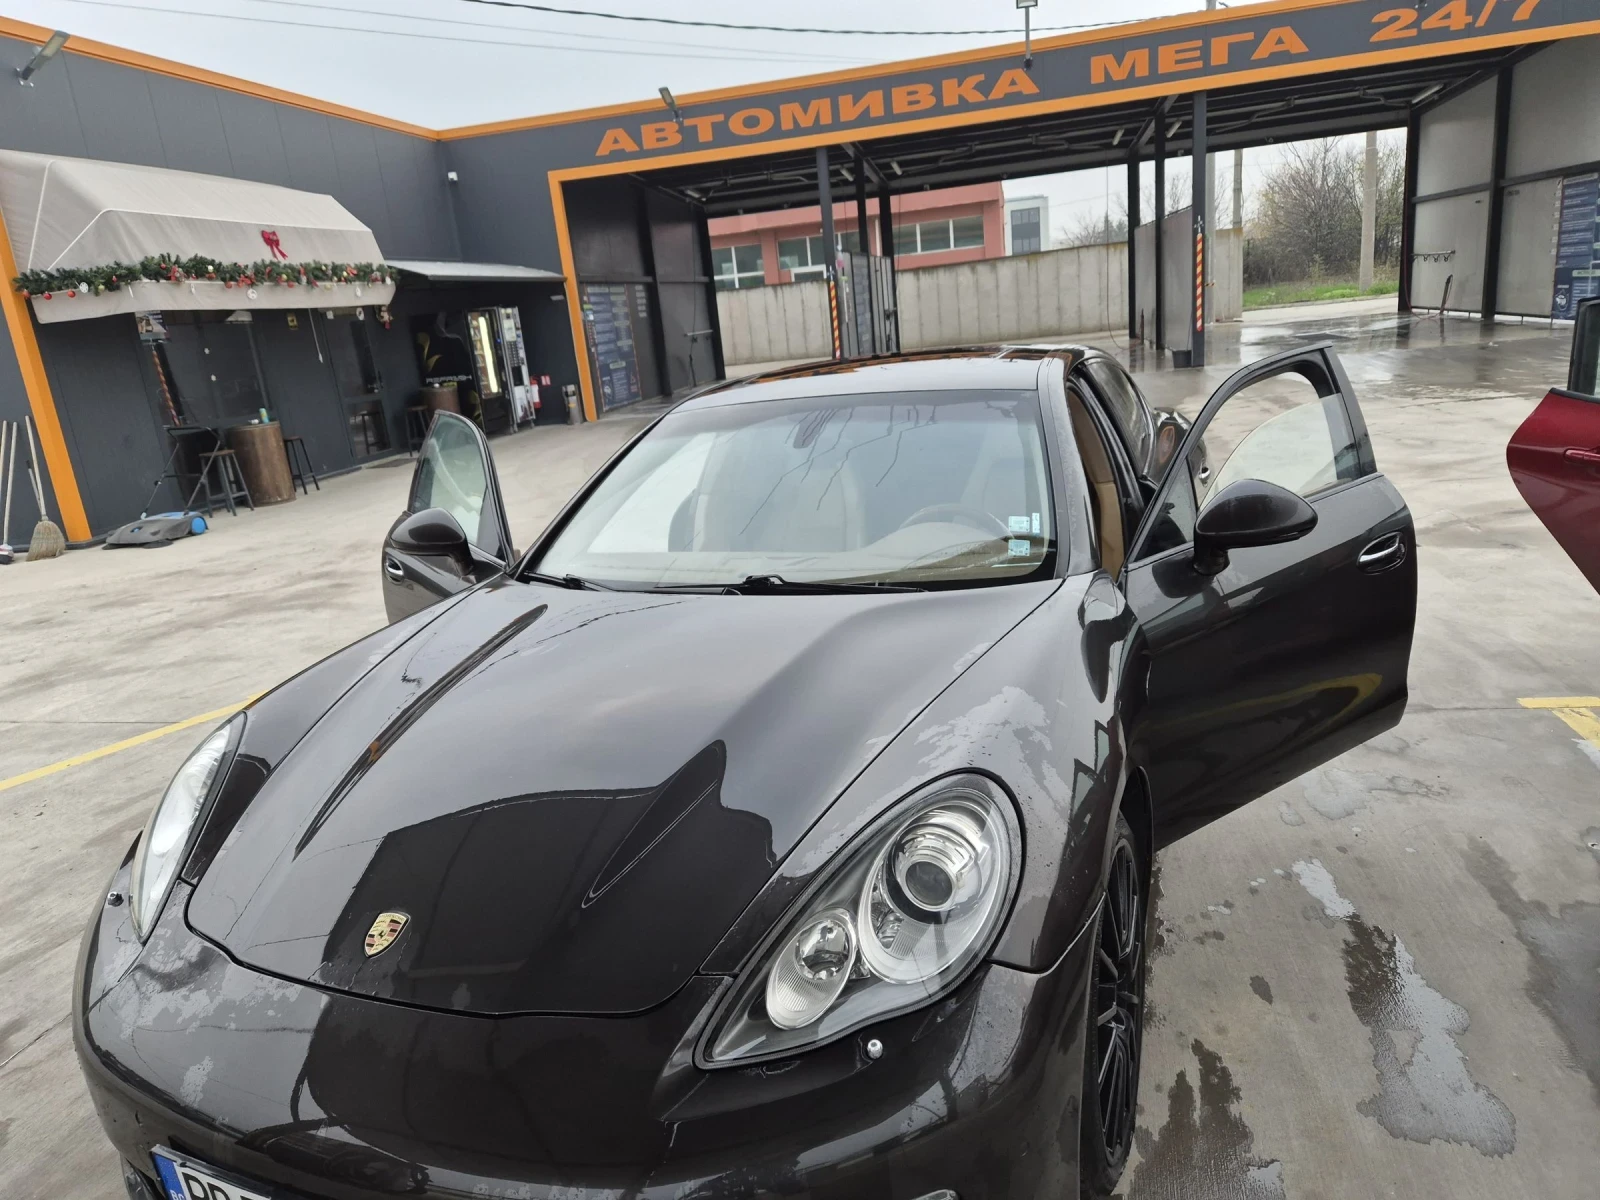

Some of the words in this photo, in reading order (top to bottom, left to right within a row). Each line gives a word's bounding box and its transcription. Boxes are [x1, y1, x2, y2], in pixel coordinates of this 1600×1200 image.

[595, 67, 1040, 157] АВТОМИВКА
[1090, 25, 1309, 85] МЕГА
[1369, 0, 1541, 42] 24/7
